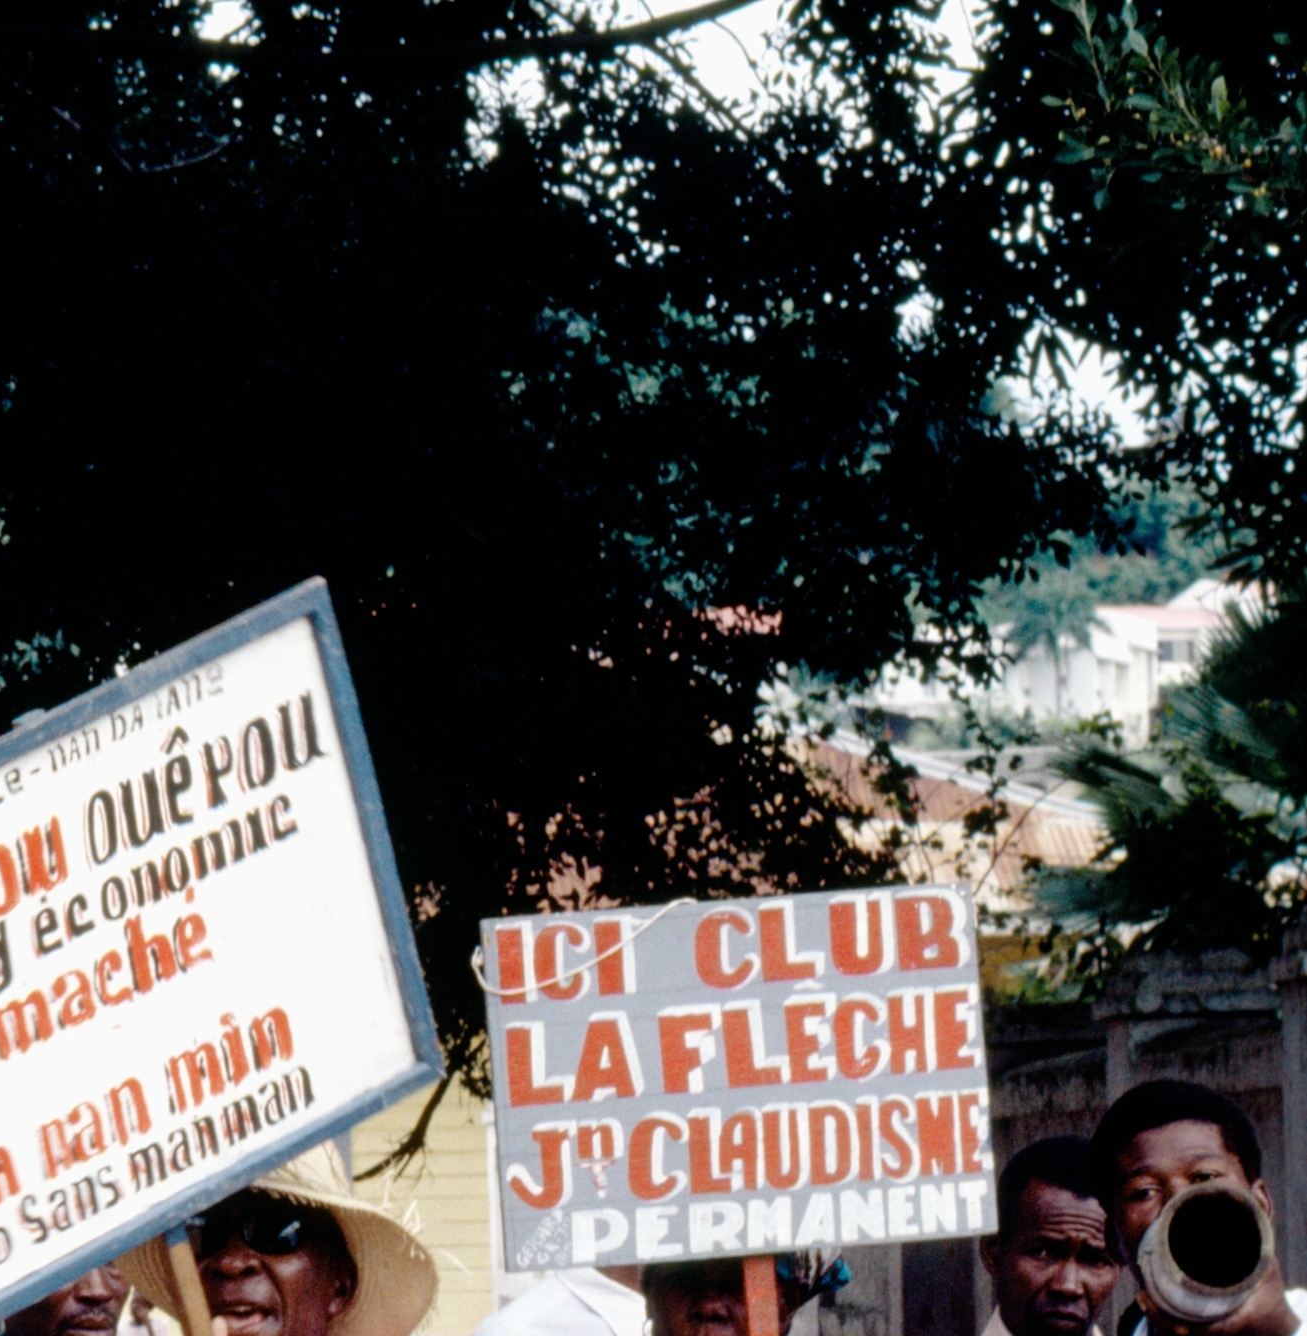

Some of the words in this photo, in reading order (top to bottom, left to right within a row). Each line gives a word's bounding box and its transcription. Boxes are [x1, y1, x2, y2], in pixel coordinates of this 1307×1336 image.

[496, 914, 638, 1005] ICI
[694, 889, 968, 994] CLUB
[505, 1011, 645, 1107] LA
[35, 1077, 153, 1180] nan
[627, 1088, 993, 1203] CLAUDISME
[572, 1181, 987, 1264] PERMANENT
